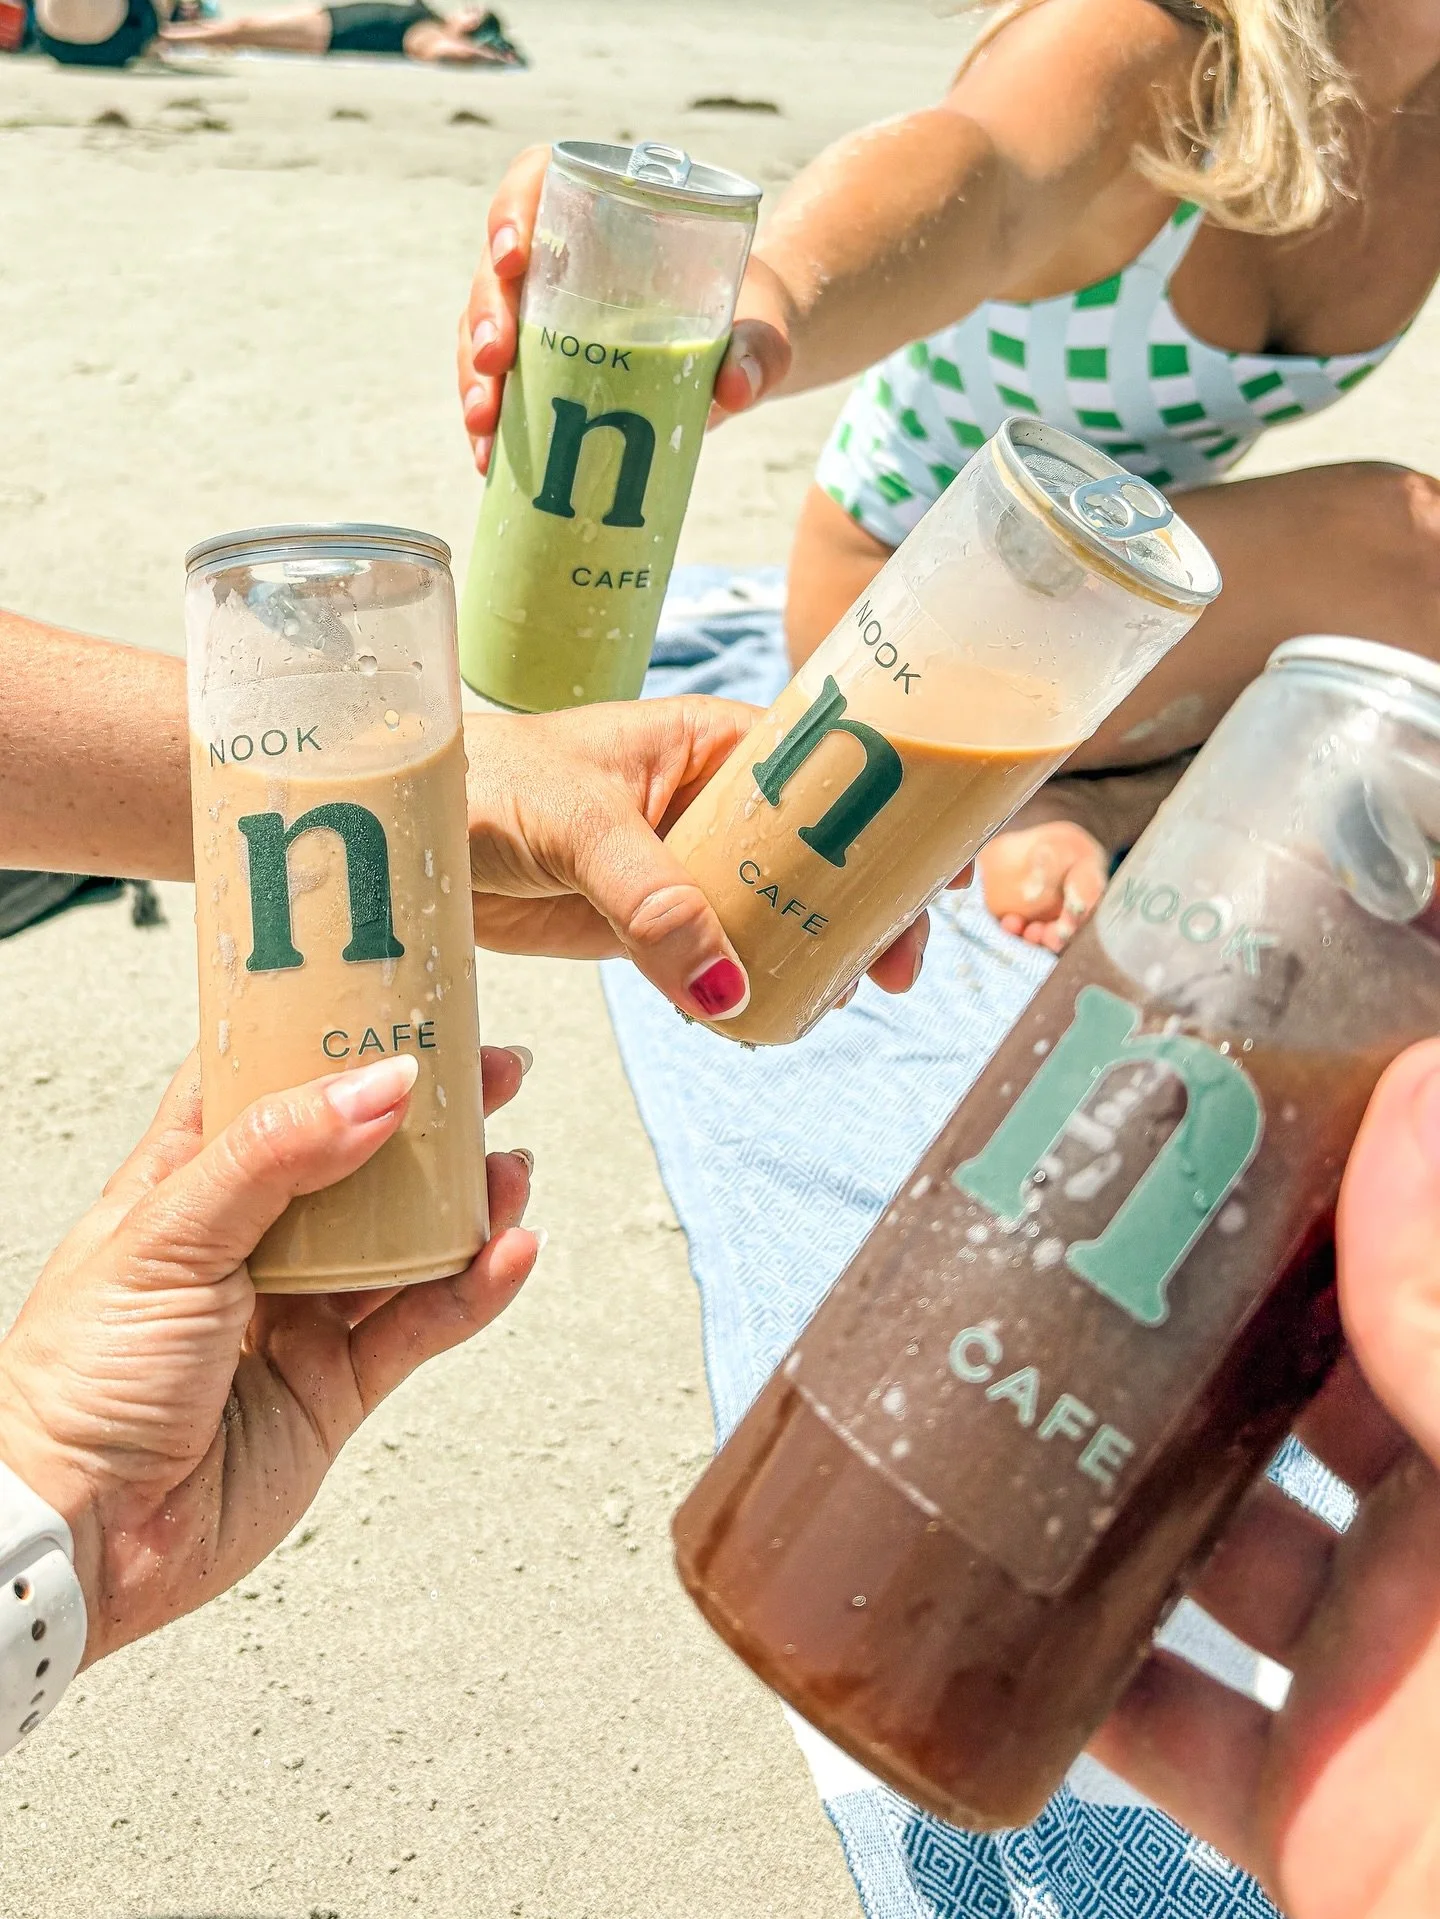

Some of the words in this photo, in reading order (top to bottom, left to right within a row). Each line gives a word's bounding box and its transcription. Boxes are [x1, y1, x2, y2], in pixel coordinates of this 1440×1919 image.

[540, 326, 632, 371] NOOK
[532, 396, 657, 529] n
[572, 566, 650, 590] CAFE
[855, 599, 922, 696] NOOK
[208, 724, 323, 768] NOOK
[751, 673, 905, 870] n
[237, 802, 405, 972] n
[737, 859, 830, 937] CAFE
[1107, 876, 1277, 976] NOOK
[321, 1020, 437, 1059] CAFE
[952, 984, 1266, 1328] n
[948, 1325, 1135, 1486] CAFE
